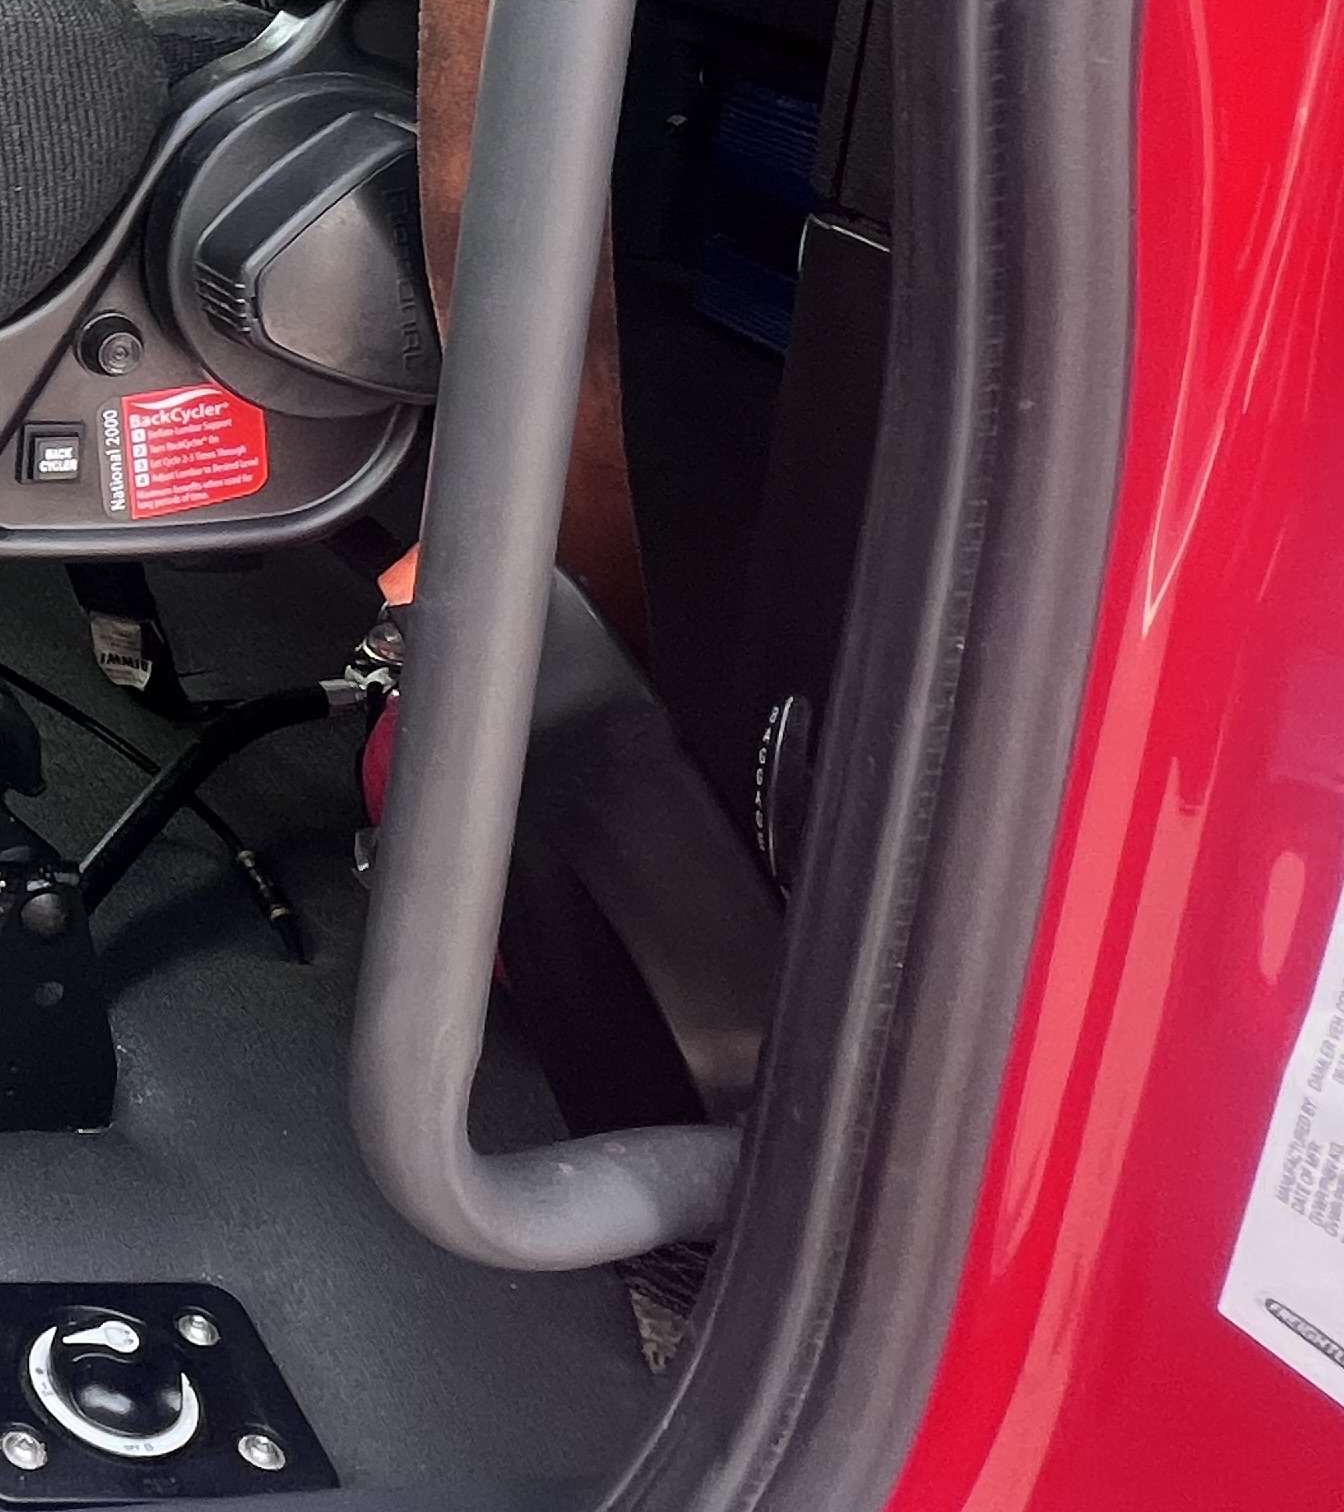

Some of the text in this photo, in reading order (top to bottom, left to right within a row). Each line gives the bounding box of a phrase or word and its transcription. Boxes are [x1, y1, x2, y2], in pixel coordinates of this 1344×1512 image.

[45, 447, 73, 460] BACK
[38, 459, 78, 472] CYCLER
[102, 409, 126, 512] National 2000
